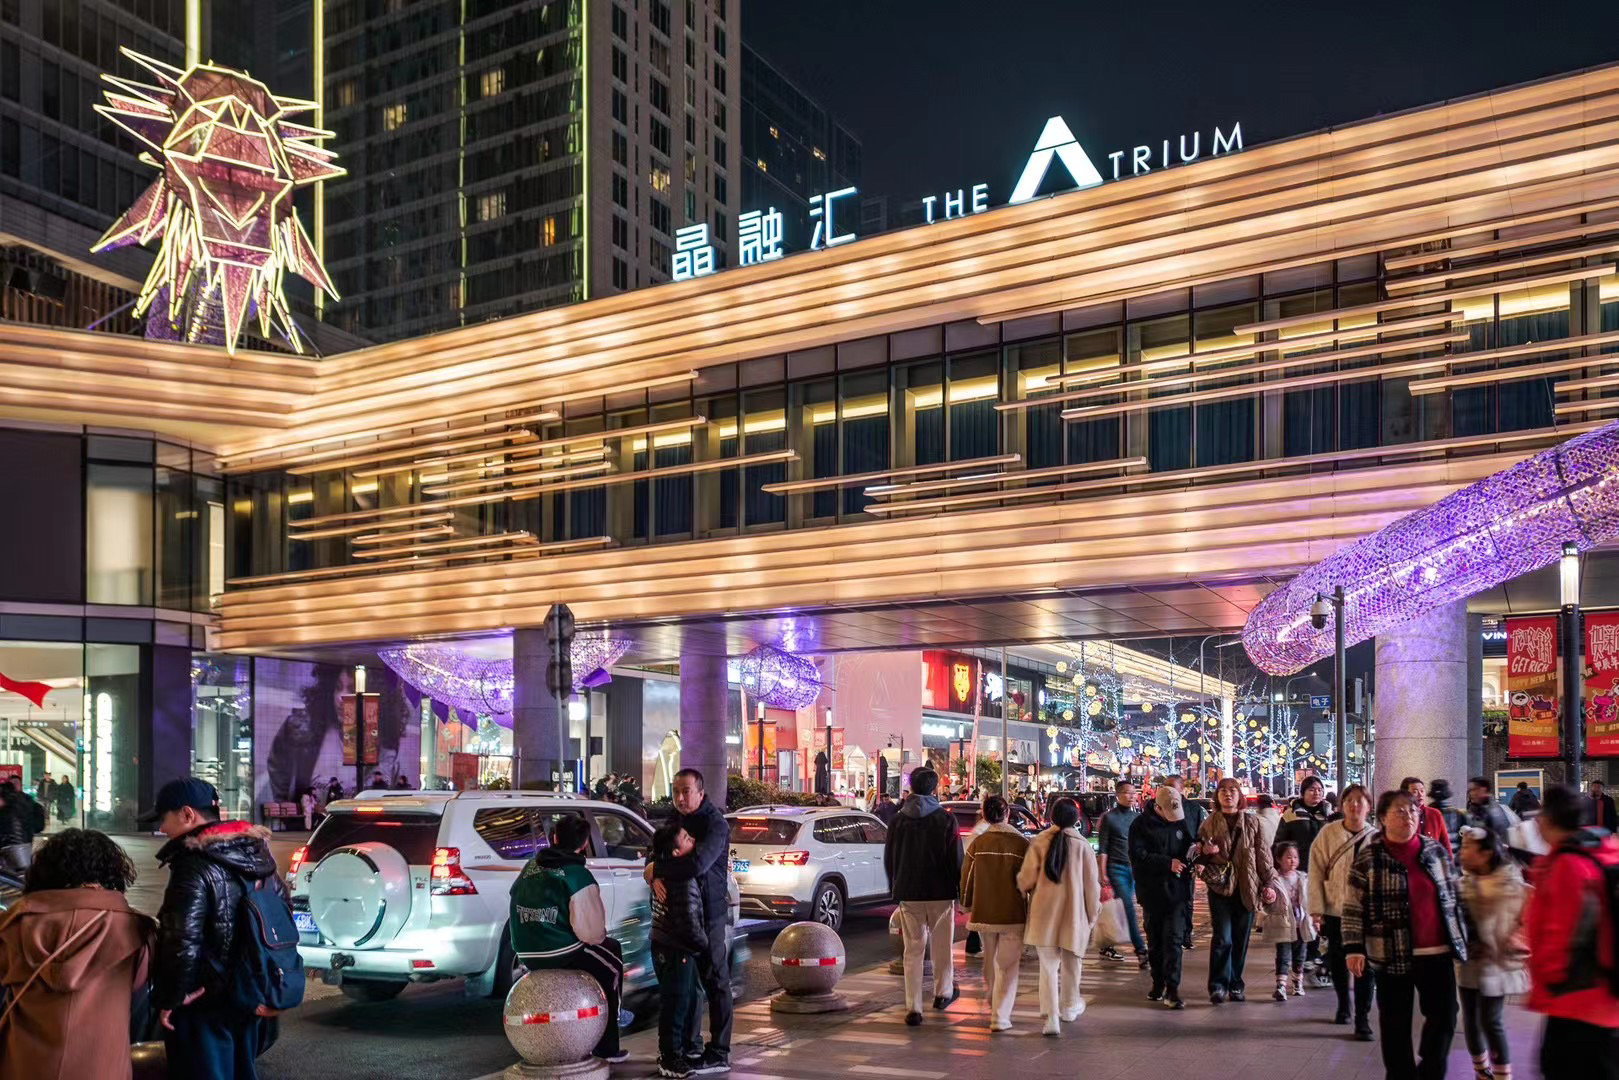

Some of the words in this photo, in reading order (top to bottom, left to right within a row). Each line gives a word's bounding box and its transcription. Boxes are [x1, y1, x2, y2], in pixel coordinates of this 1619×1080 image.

[922, 183, 989, 225] THE
[1008, 115, 1243, 206] ATRIUM
[672, 187, 857, 282] 晶融汇
[1512, 655, 1531, 673] GET
[1528, 660, 1550, 673] RICH
